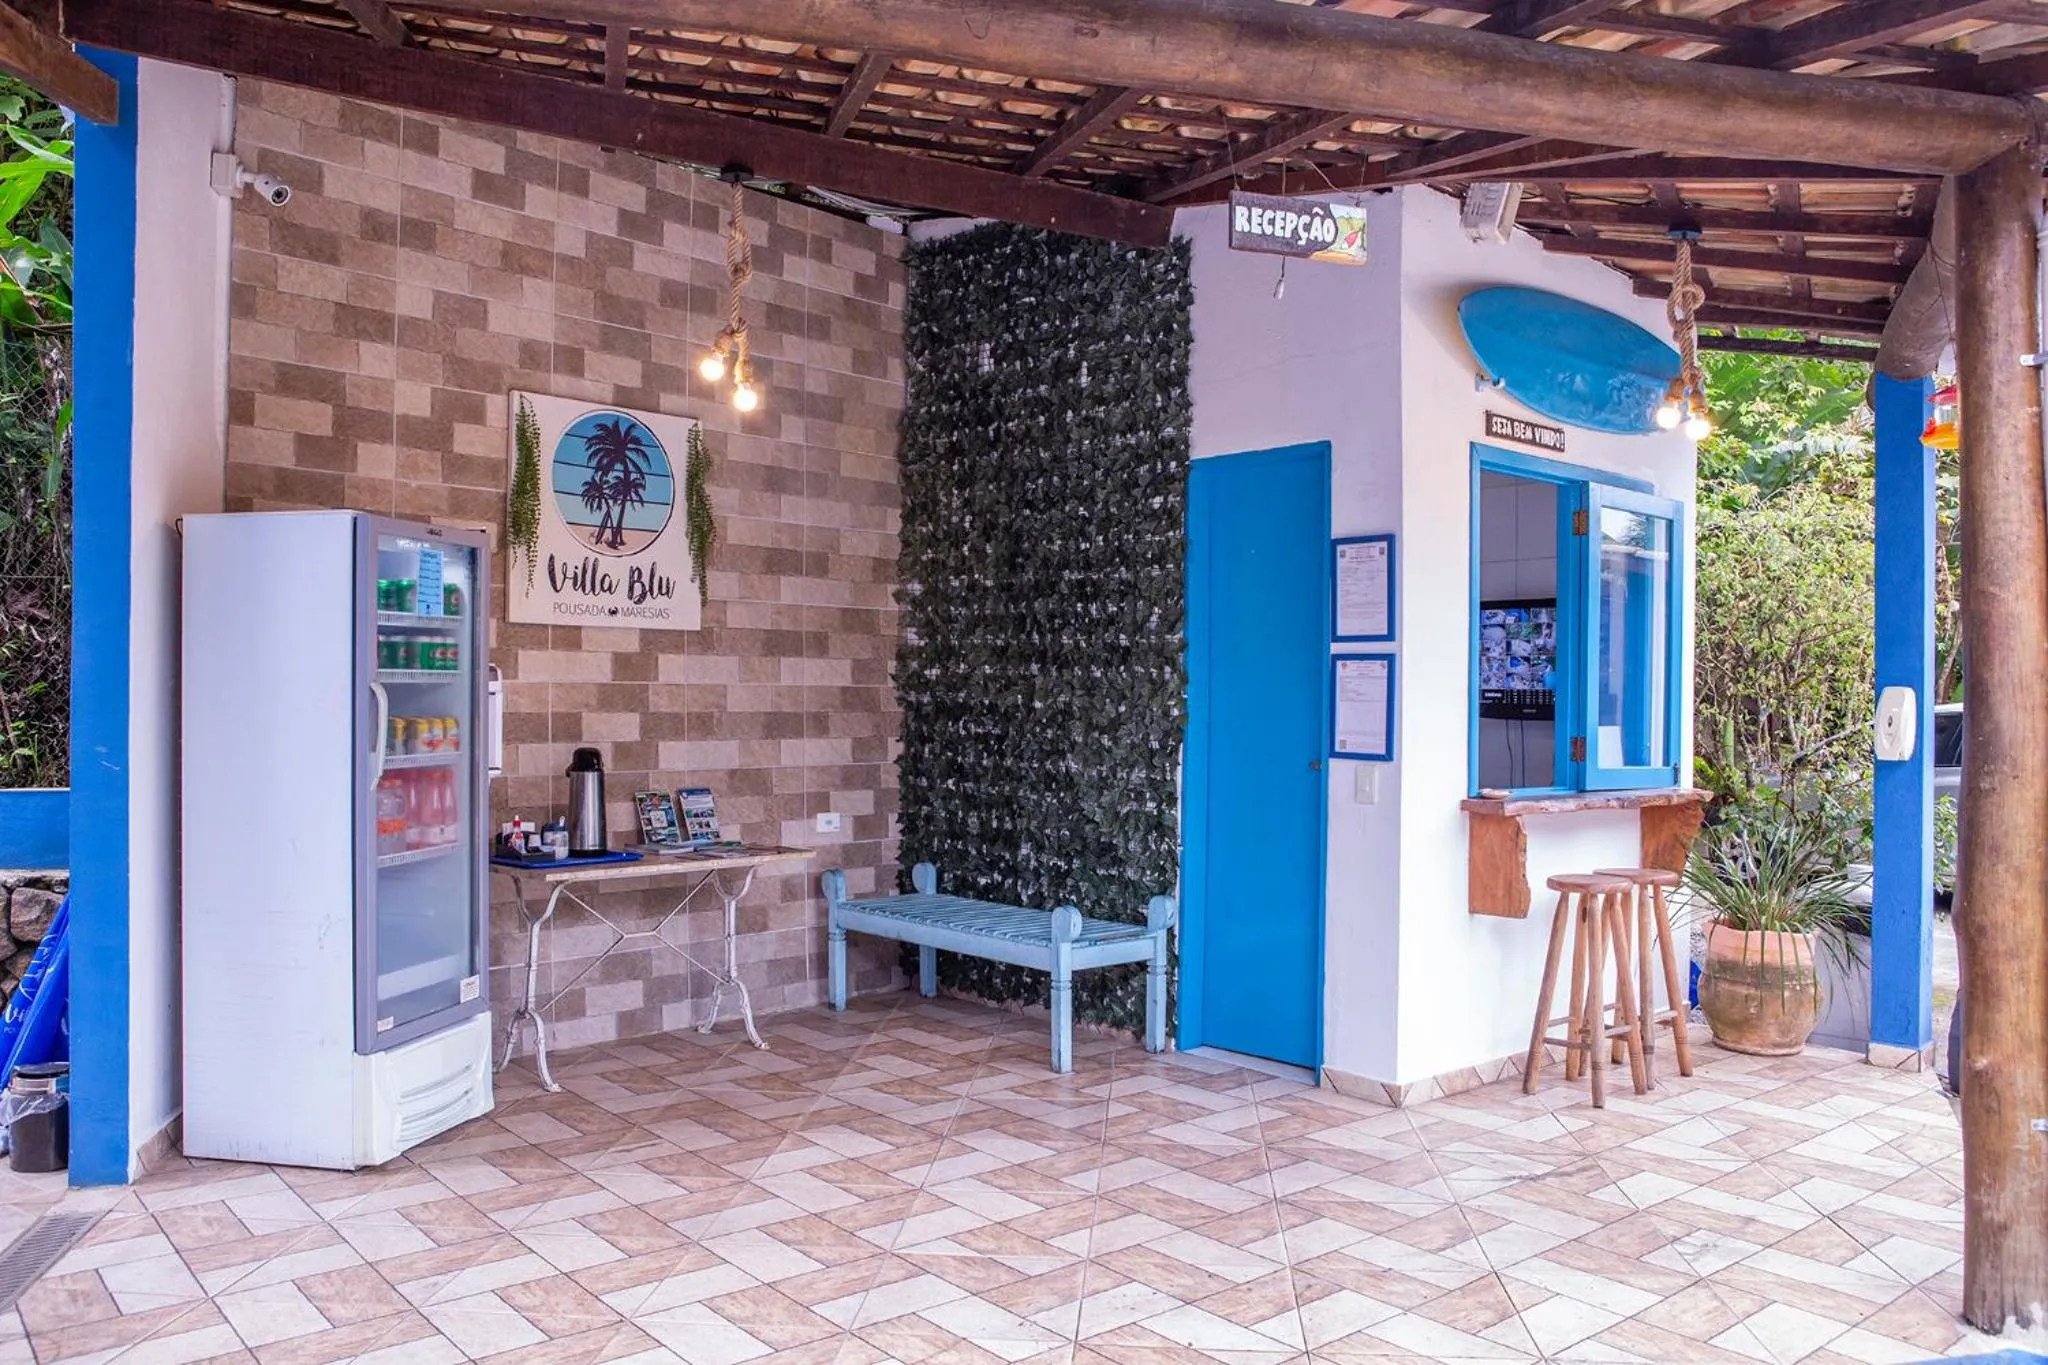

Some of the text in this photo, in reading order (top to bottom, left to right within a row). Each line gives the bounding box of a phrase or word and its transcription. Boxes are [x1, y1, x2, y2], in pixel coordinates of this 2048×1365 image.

[1235, 206, 1336, 245] RECEPÇÃO
[1491, 416, 1512, 437] SEJA
[1513, 421, 1533, 440] BEM
[547, 553, 676, 605] Villa Blu
[553, 602, 670, 620] POUSADA MARESIAS
